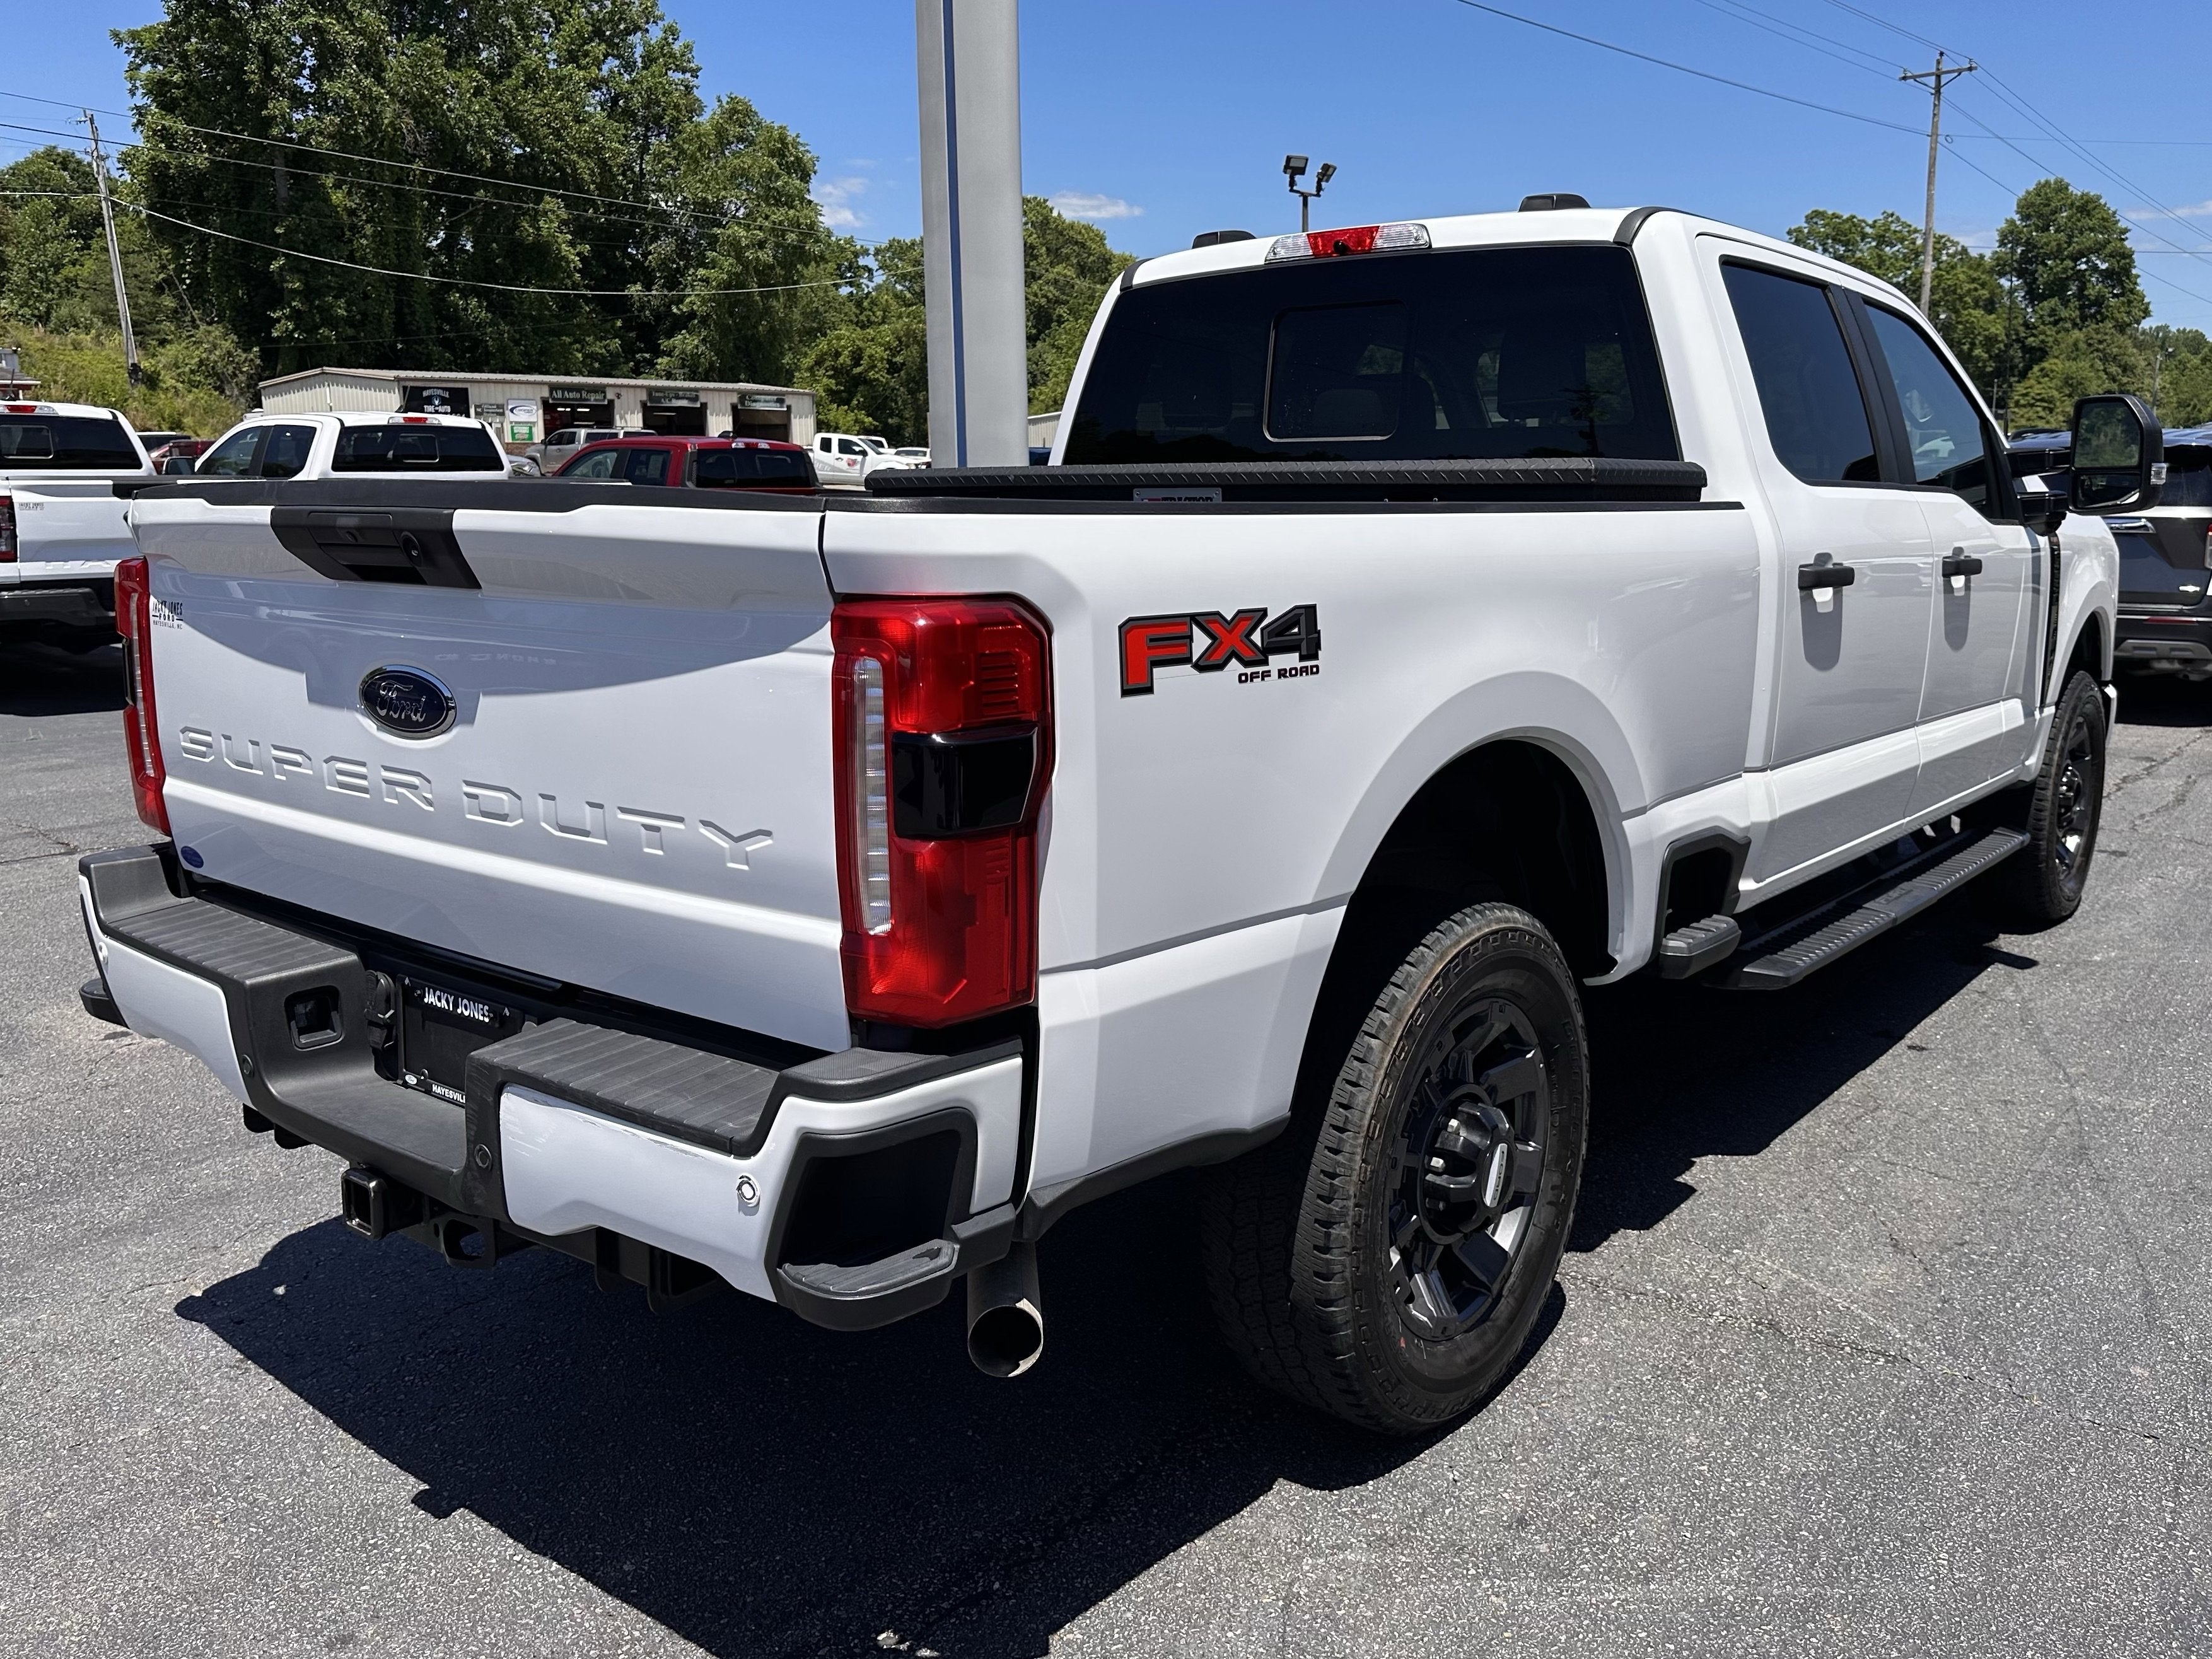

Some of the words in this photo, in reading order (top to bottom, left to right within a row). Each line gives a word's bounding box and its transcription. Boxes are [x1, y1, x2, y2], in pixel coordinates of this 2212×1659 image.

[552, 390, 562, 399] All
[563, 390, 580, 399] Auto
[581, 390, 605, 401] Repair
[152, 600, 167, 613] JACKY
[168, 601, 183, 616] JONES
[159, 613, 175, 622] FORD
[1118, 603, 1322, 698] FX4
[1237, 671, 1271, 684] OFF
[1278, 664, 1320, 679] ROAD
[376, 680, 426, 723] Ford
[180, 726, 434, 812] SUPER
[462, 779, 773, 870] DUTY
[424, 987, 454, 1011] JACKY
[457, 997, 489, 1023] JONES
